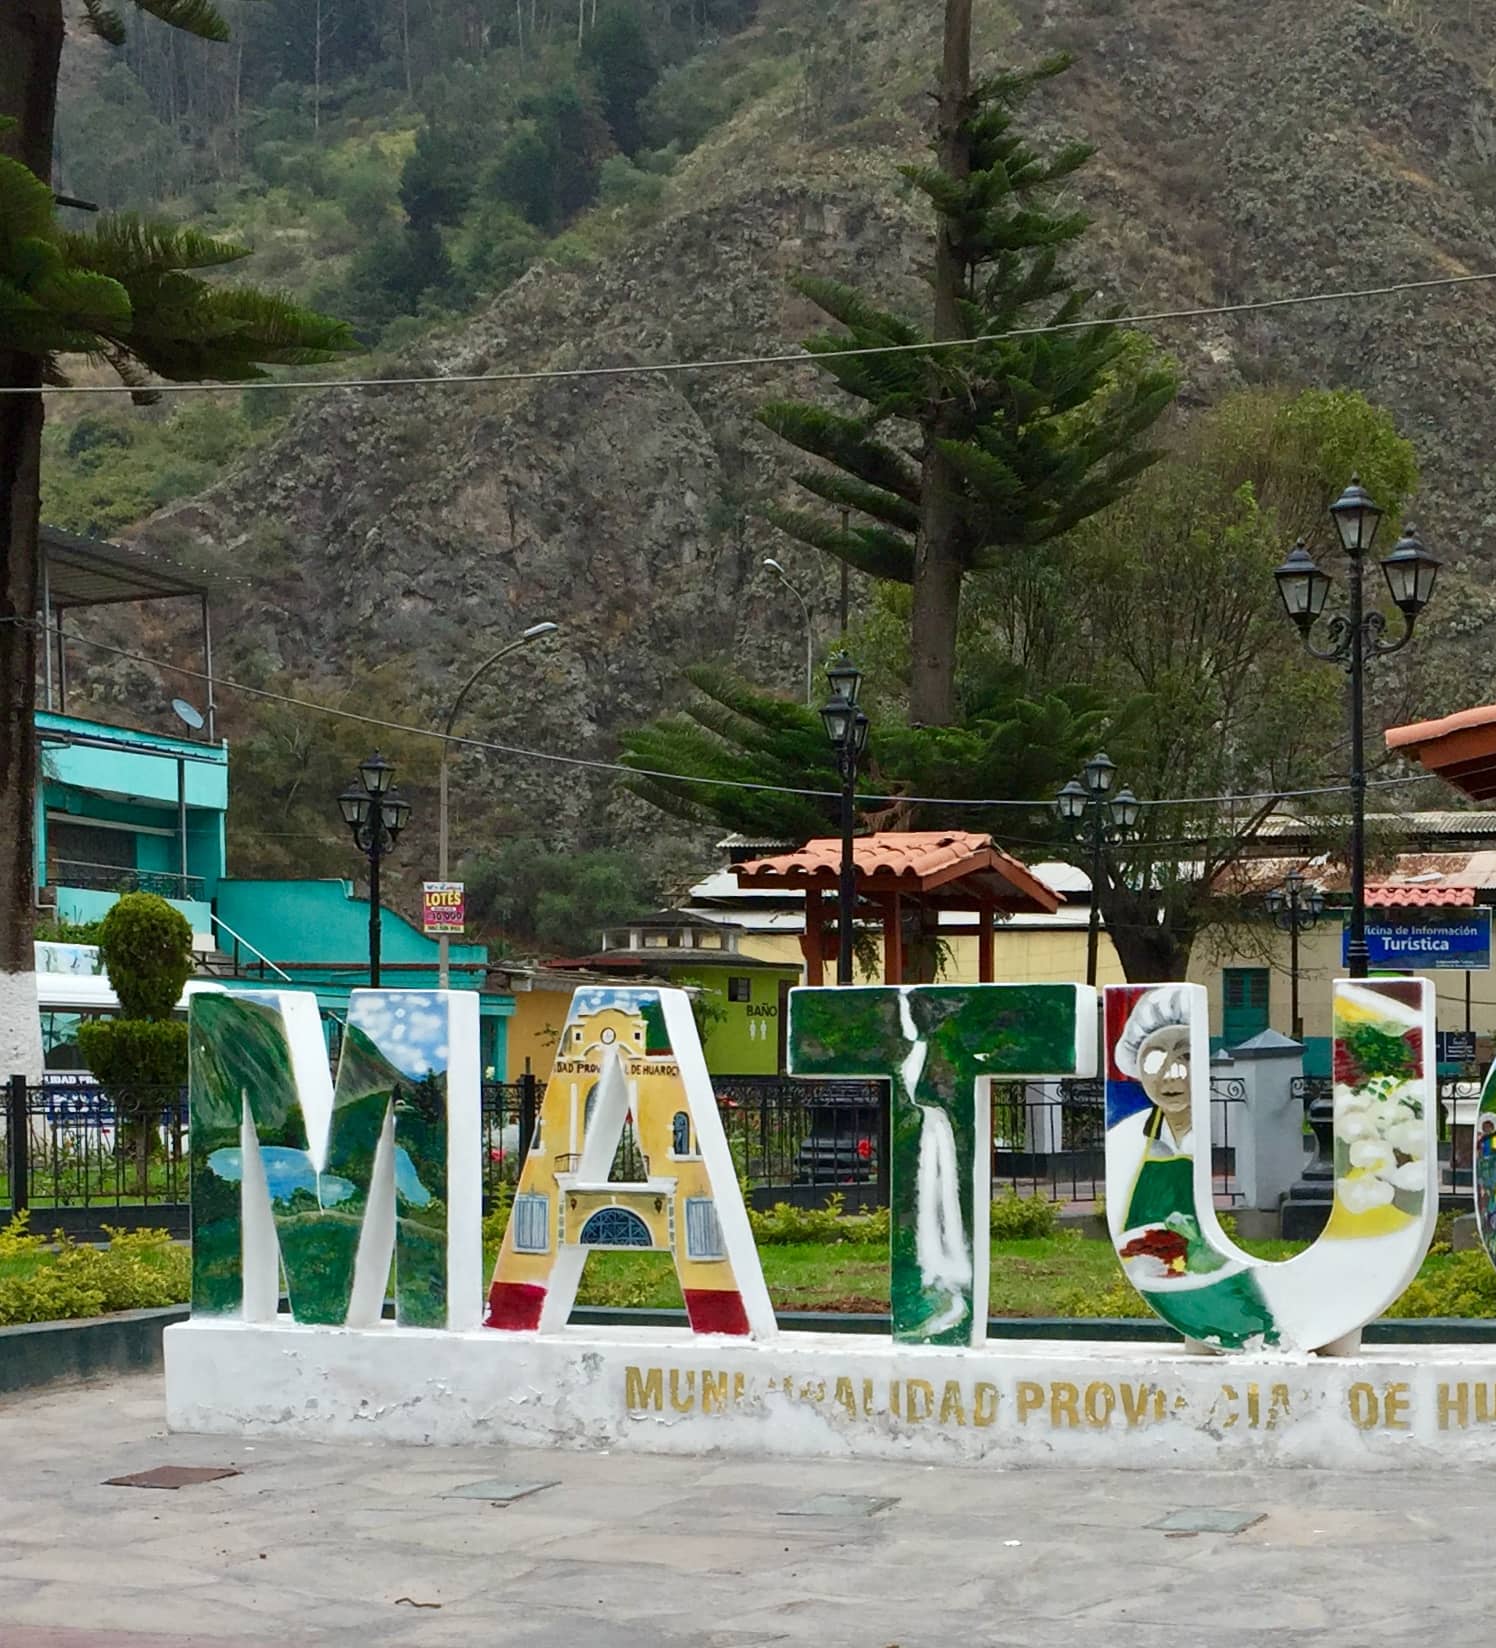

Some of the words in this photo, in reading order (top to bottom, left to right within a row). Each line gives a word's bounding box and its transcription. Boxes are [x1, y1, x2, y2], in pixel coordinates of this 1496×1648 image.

[425, 890, 461, 906] LOTES
[1363, 925, 1393, 936] ficina
[1395, 925, 1409, 936] de
[1411, 925, 1478, 936] Información
[1381, 936, 1449, 951] Turística
[746, 1002, 777, 1016] BAÑO
[625, 1366, 998, 1427] MUNIALIDAD
[1348, 1381, 1410, 1430] DE
